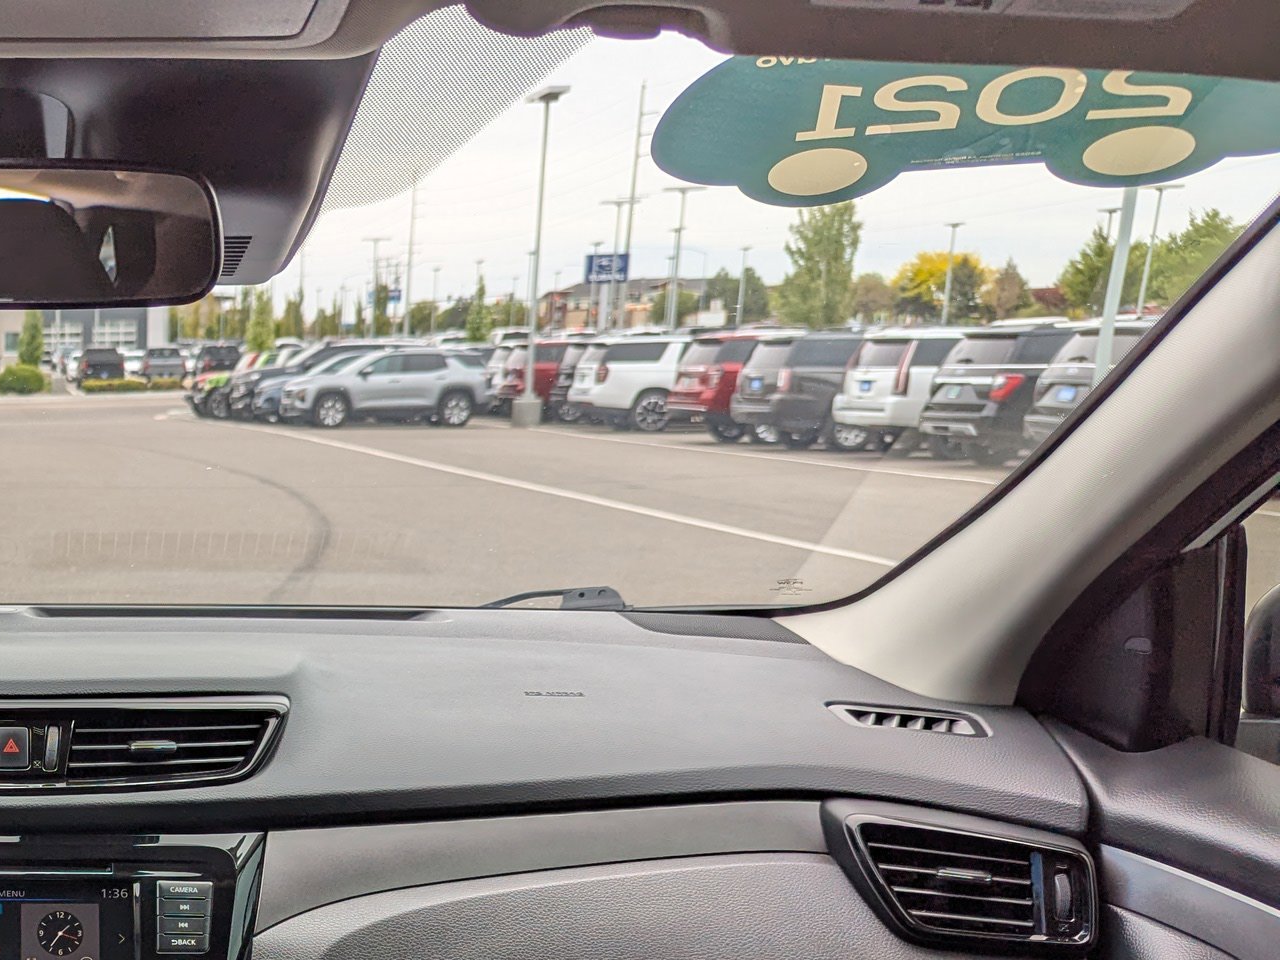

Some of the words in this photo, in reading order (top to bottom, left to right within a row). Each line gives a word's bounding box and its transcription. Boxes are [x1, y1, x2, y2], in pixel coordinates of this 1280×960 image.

[100, 888, 129, 899] 1:36
[169, 886, 199, 894] CAMERA
[55, 911, 65, 919] 12
[38, 929, 45, 937] 9
[57, 948, 63, 956] 6
